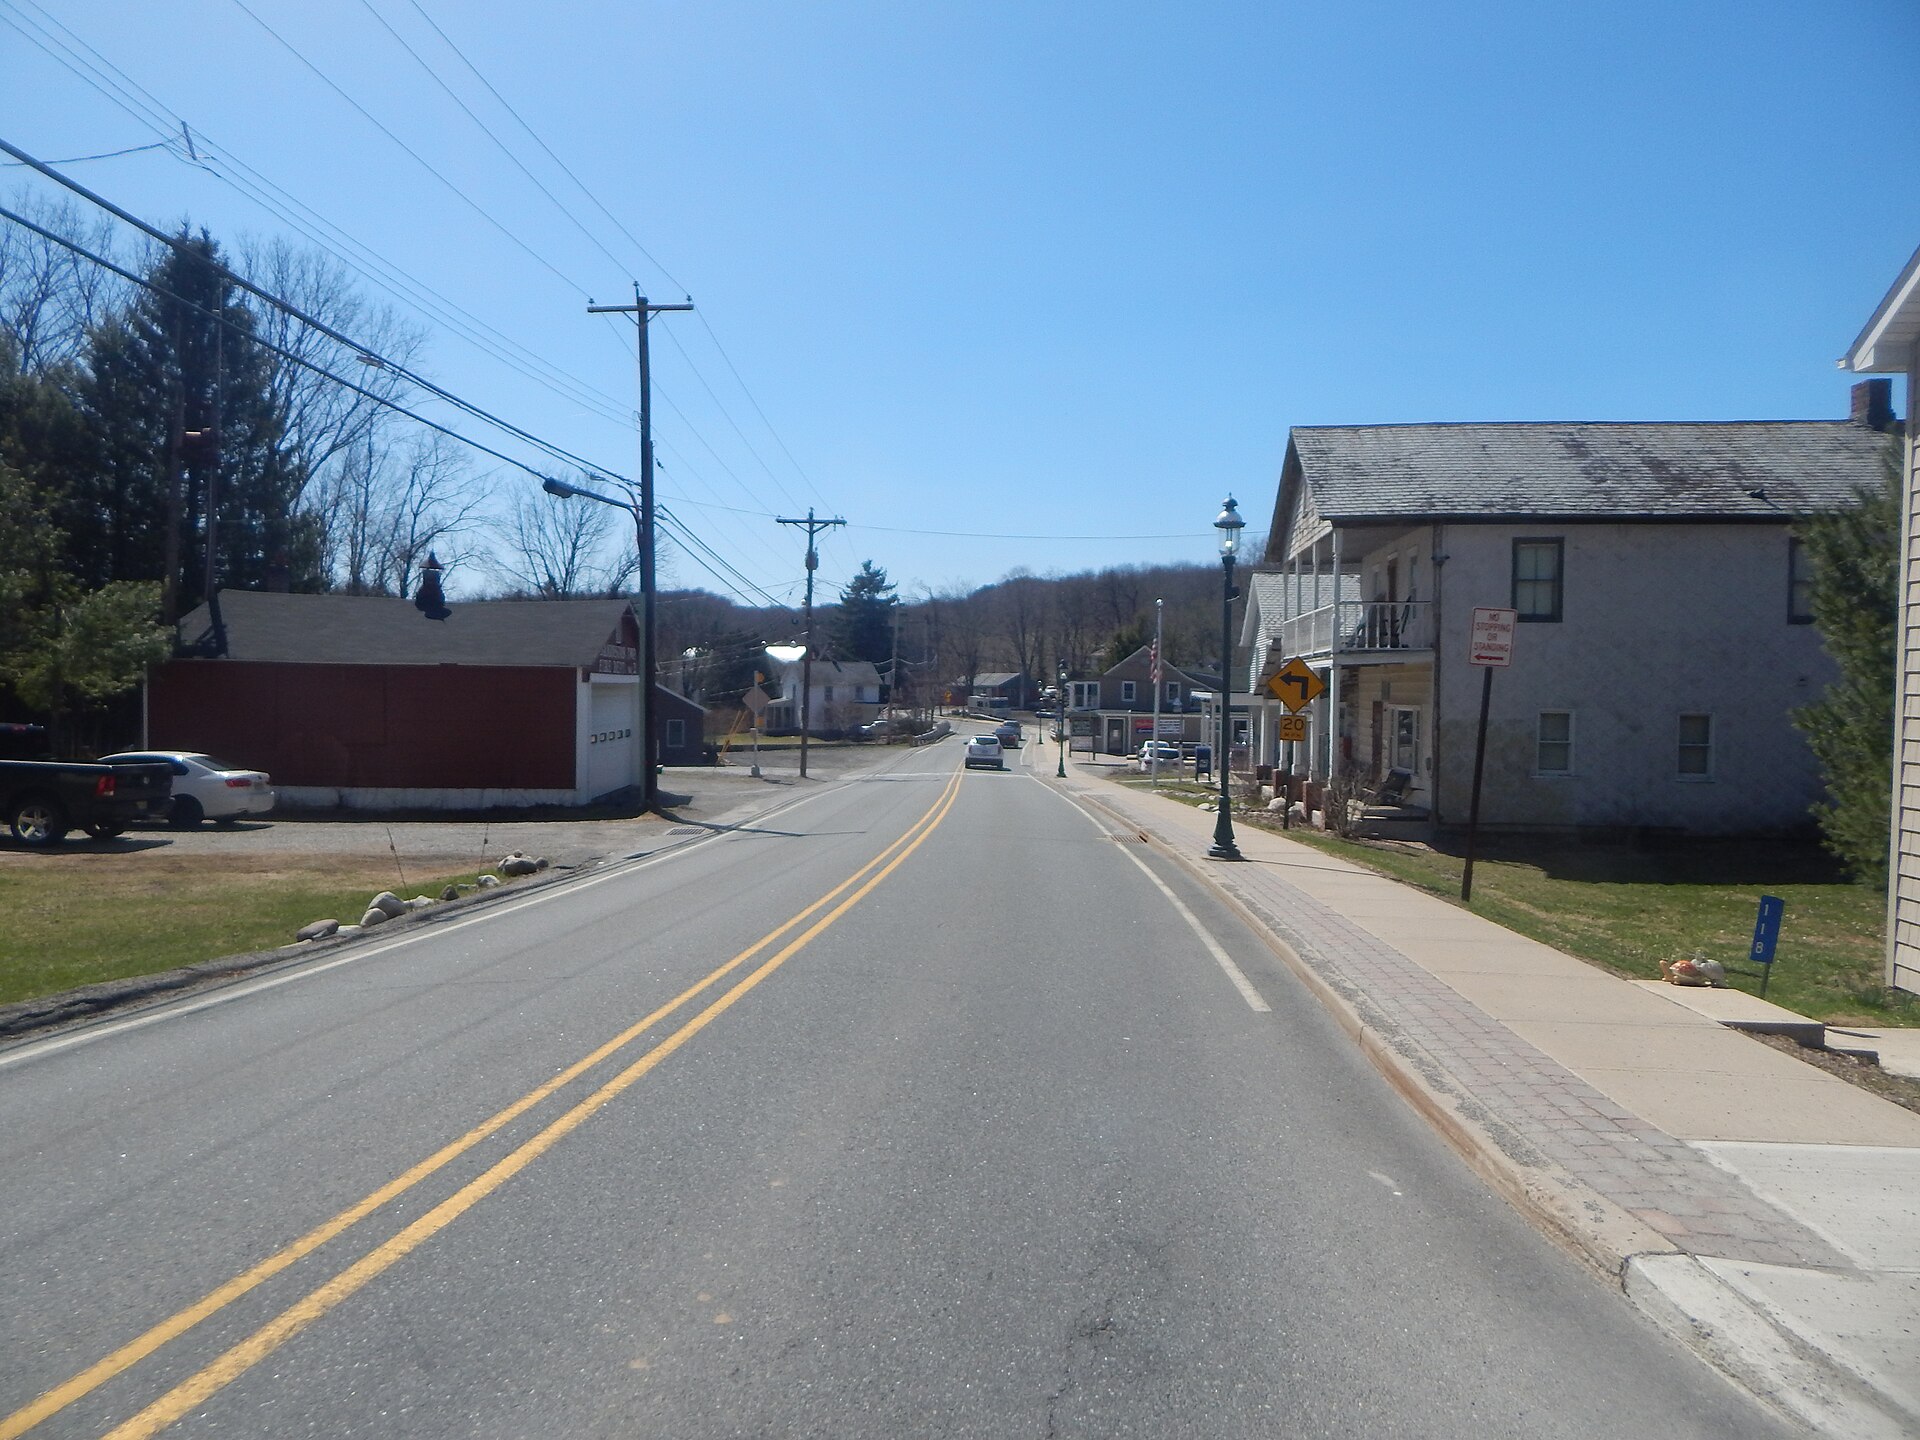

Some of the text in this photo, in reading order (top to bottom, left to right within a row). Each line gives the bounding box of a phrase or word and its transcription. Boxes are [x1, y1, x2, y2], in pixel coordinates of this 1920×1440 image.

[1488, 612, 1500, 622] NO
[1476, 622, 1511, 633] STOPPING
[1487, 633, 1498, 641] OR
[1474, 642, 1509, 652] STANDING
[1283, 718, 1304, 731] 20
[1755, 904, 1769, 954] 118
